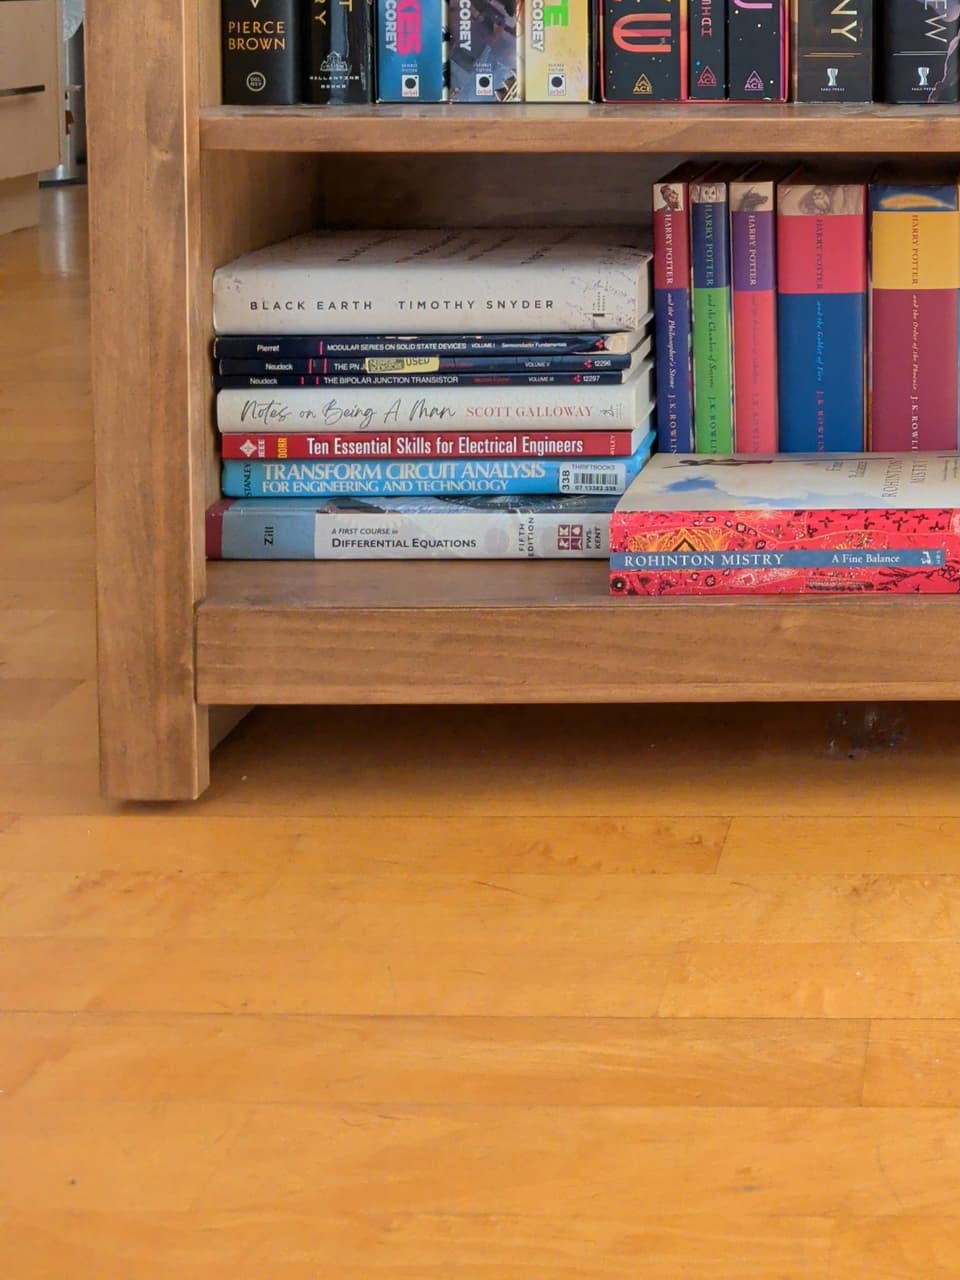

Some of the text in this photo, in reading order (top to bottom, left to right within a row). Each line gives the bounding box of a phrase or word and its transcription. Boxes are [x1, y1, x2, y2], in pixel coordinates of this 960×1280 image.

[228, 21, 285, 33] PIERCE
[229, 38, 285, 50] BROWN
[251, 300, 553, 310] BLACK EARTH TIMOTHY SNYDER
[257, 344, 279, 352] Pierret
[327, 344, 359, 352] MODULAR
[373, 376, 409, 384] JUNCTION
[411, 376, 458, 384] TRANSISTOR
[241, 398, 593, 429] Notes on Being A Man SCOTT GALLOWAY
[307, 436, 583, 456] Ten Essential Skills for Electrical Engineers
[263, 462, 546, 480] TRANSFORM CIRCUIT ANALYSIS
[262, 479, 508, 493] FOR ENGINEERING AND TECHNOLOGY
[332, 538, 476, 548] DIFFERENTIAL EQUATIONS
[624, 552, 784, 567] ROHINTON MISTRY
[832, 553, 900, 563] A Fine Balance
